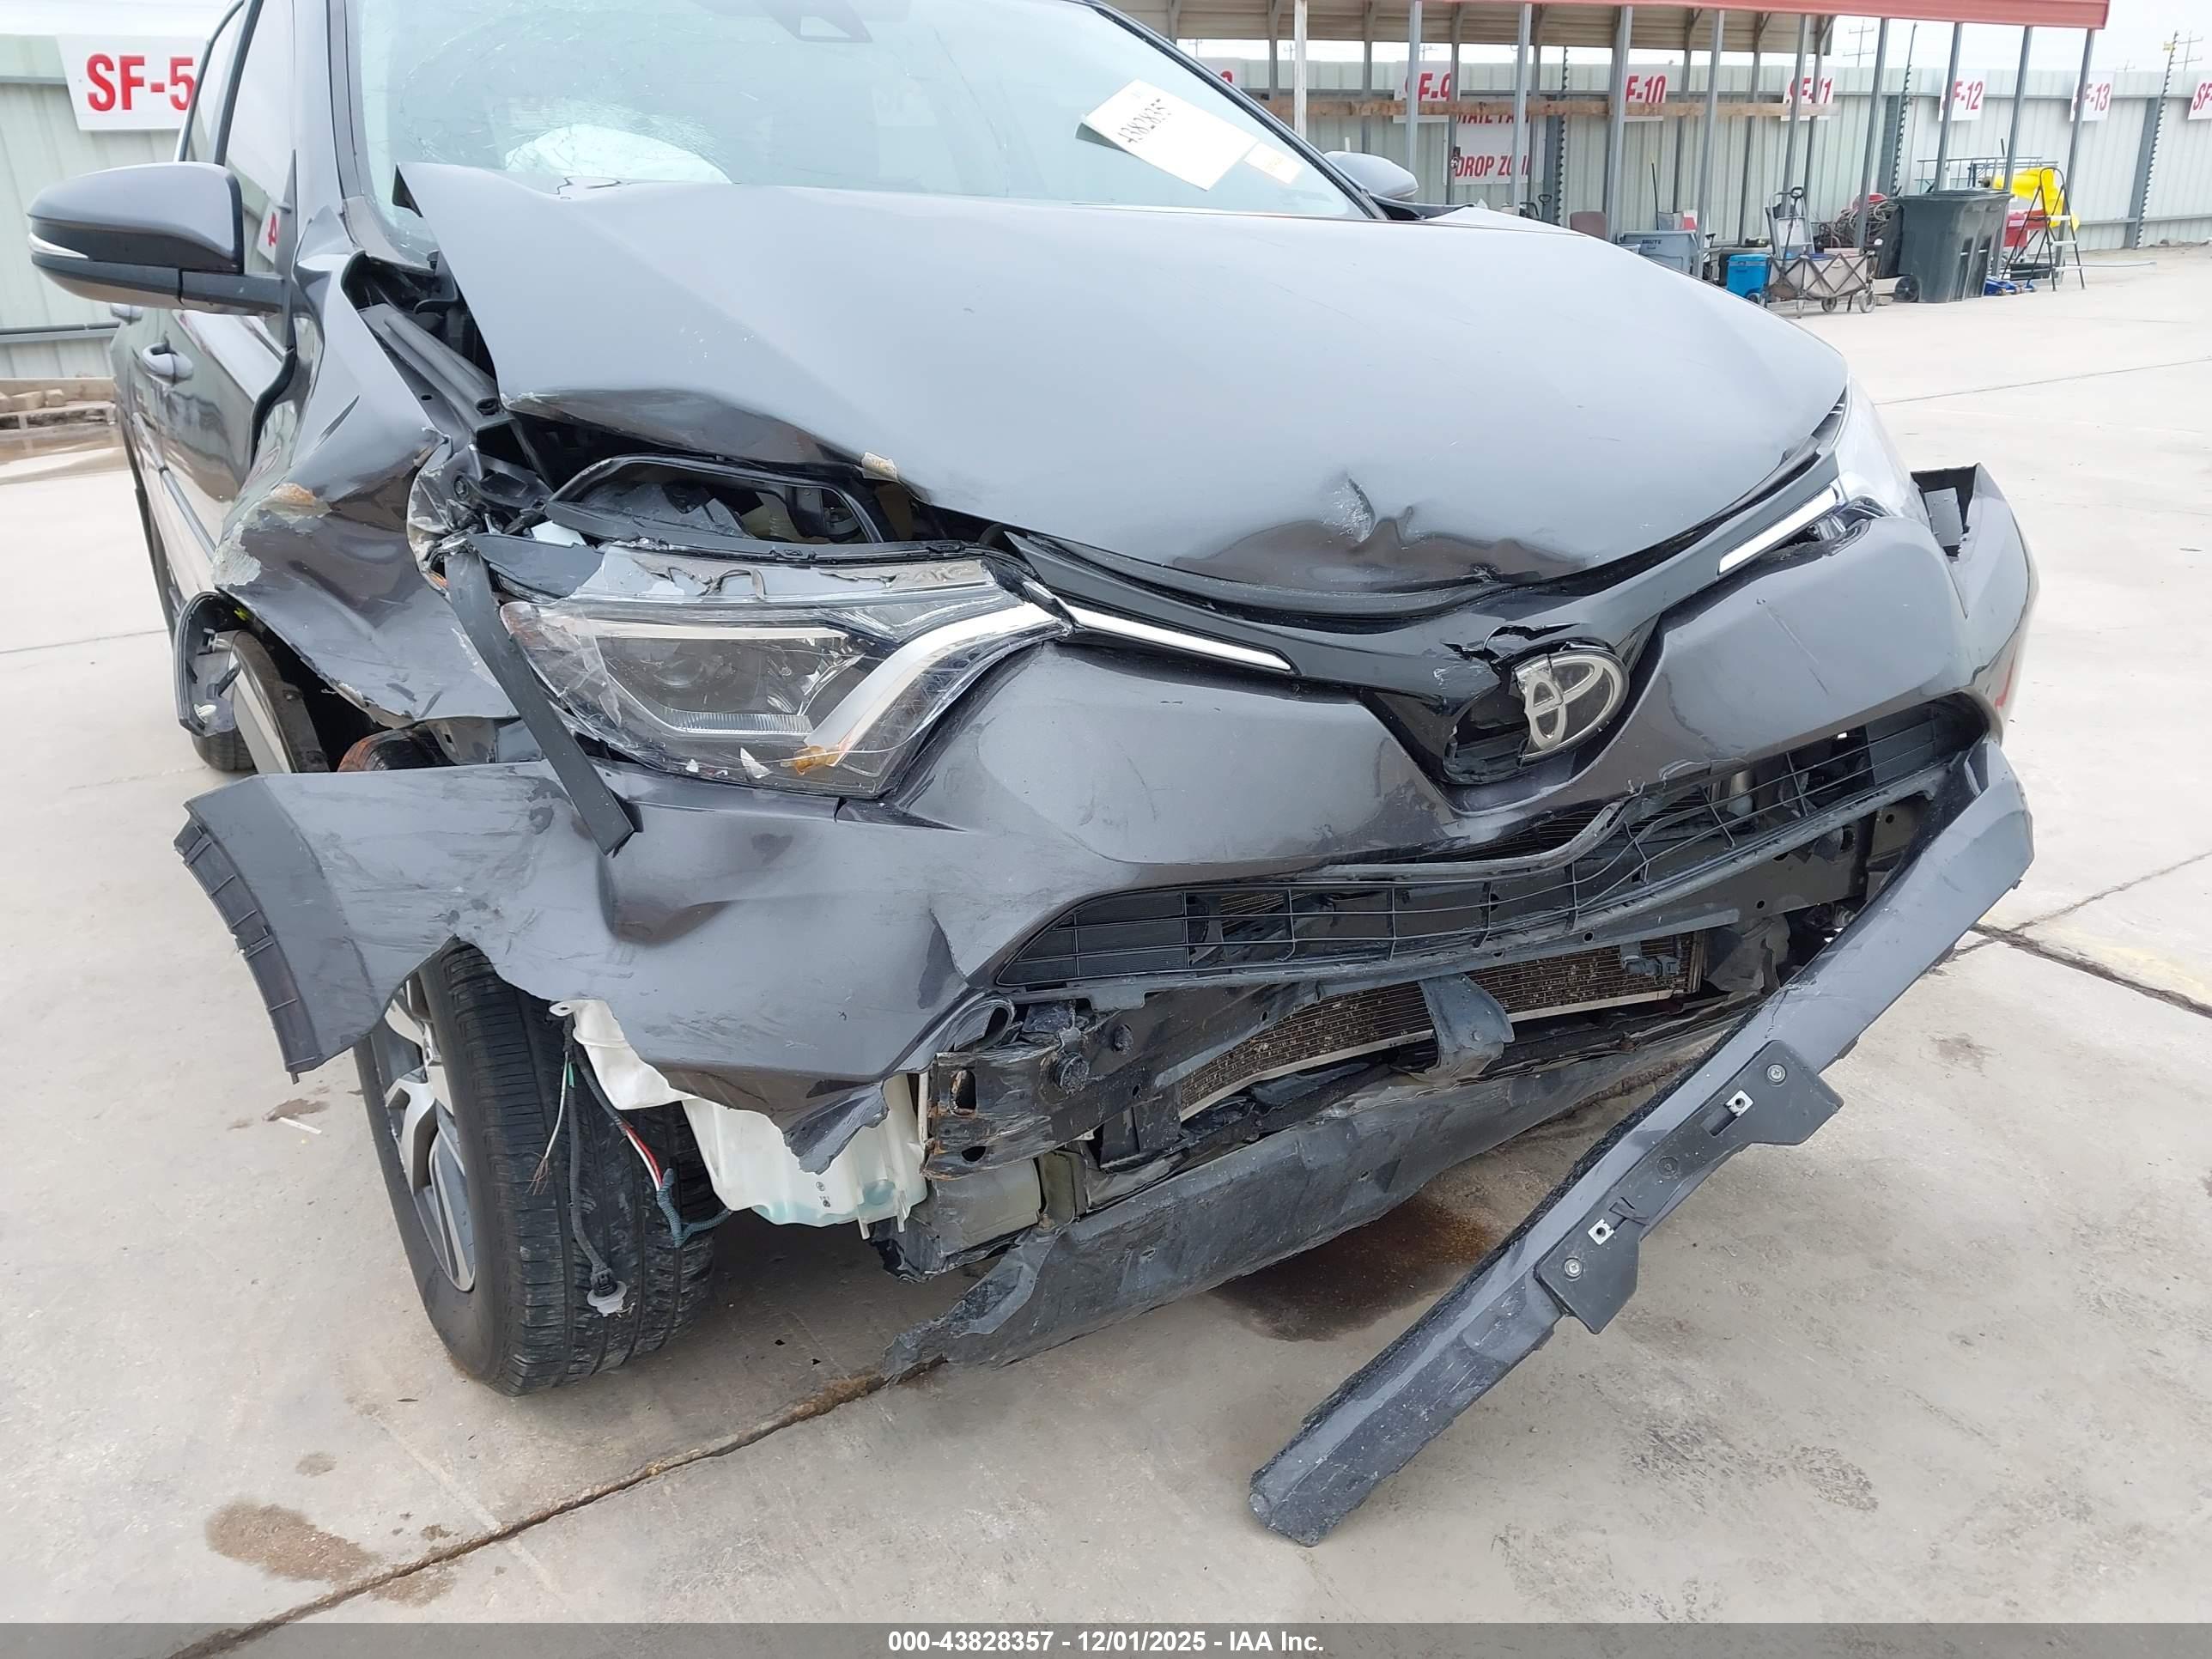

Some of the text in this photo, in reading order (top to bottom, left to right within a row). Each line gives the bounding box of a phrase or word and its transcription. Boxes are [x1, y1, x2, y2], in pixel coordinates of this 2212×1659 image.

[87, 53, 194, 112] SF-5
[1405, 72, 1449, 100] F-9
[1626, 75, 1666, 103] F-10
[1942, 81, 1984, 110] F-12
[2074, 82, 2111, 111] F-13
